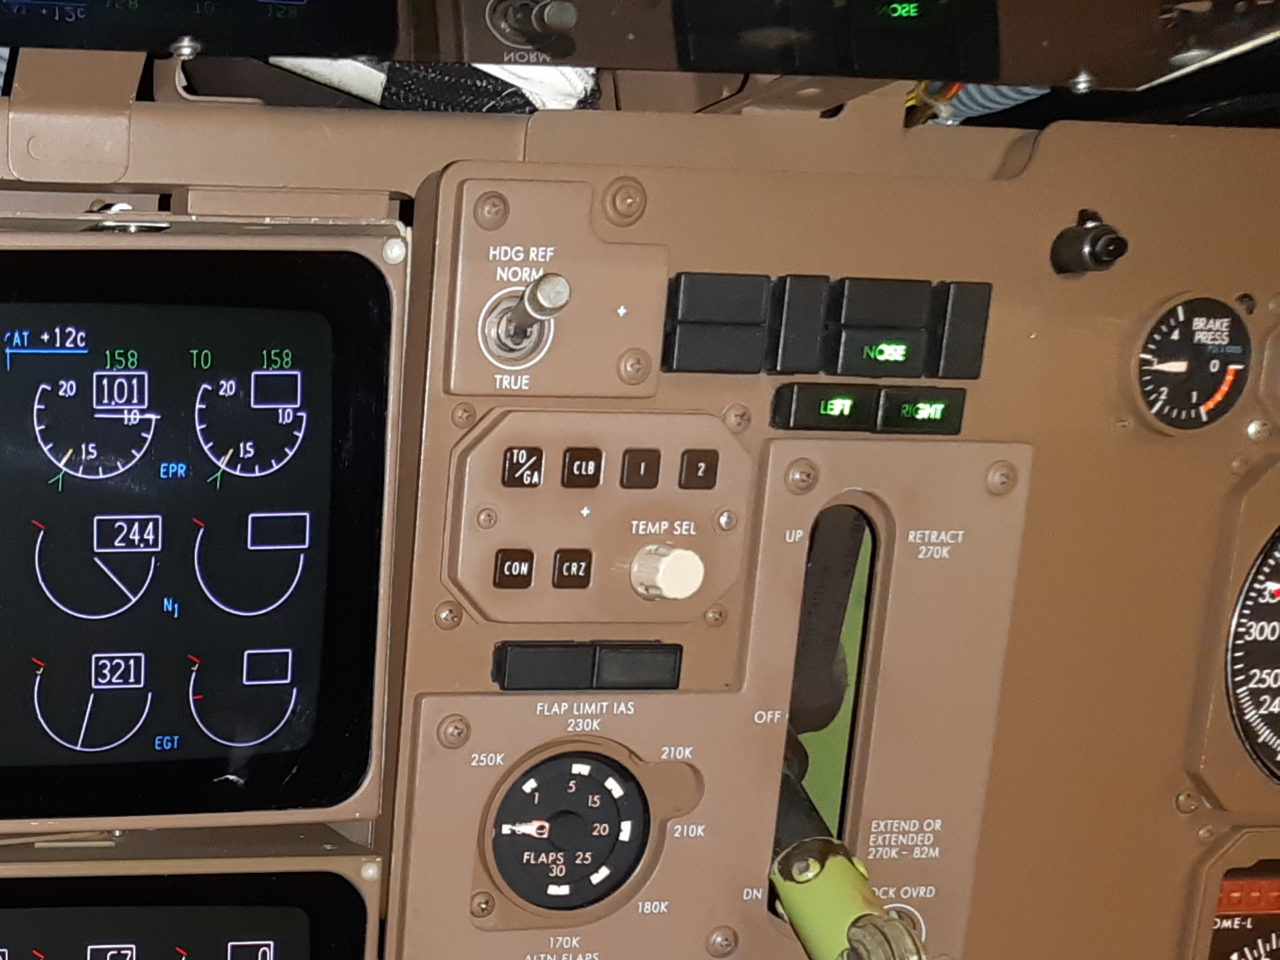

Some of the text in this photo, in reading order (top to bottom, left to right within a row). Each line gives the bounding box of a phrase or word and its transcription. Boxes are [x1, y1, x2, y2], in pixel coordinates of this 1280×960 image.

[488, 246, 555, 261] HDG REF
[1192, 317, 1232, 331] BRAKE
[1193, 331, 1230, 345] PRESS
[189, 350, 211, 370] TO
[494, 375, 530, 390] TRUE
[160, 463, 186, 478] EPR
[573, 461, 595, 474] CLB
[630, 520, 696, 535] TEMP SEL
[785, 529, 804, 543] UP
[907, 530, 965, 544] RETRACT
[917, 546, 951, 559] 270K
[504, 562, 528, 576] CON
[562, 562, 586, 576] CRZ
[97, 659, 136, 684] 321
[536, 702, 635, 715] FLAP LIMIT IAS
[754, 710, 782, 724] OFF
[567, 719, 601, 732] 230K
[154, 736, 179, 750] EGT
[470, 753, 505, 766] 250K
[660, 747, 694, 760] 210K
[592, 824, 609, 836] 20
[673, 824, 706, 838] 210K
[871, 819, 942, 832] EXTEND OR
[869, 833, 934, 846] EXTENDED
[522, 852, 565, 865] FLAPS
[575, 851, 592, 864] 25
[548, 864, 566, 877] 30
[743, 888, 763, 900] DN
[900, 886, 936, 898] OVRD
[637, 901, 669, 914] 180K
[549, 936, 581, 949] 170K
